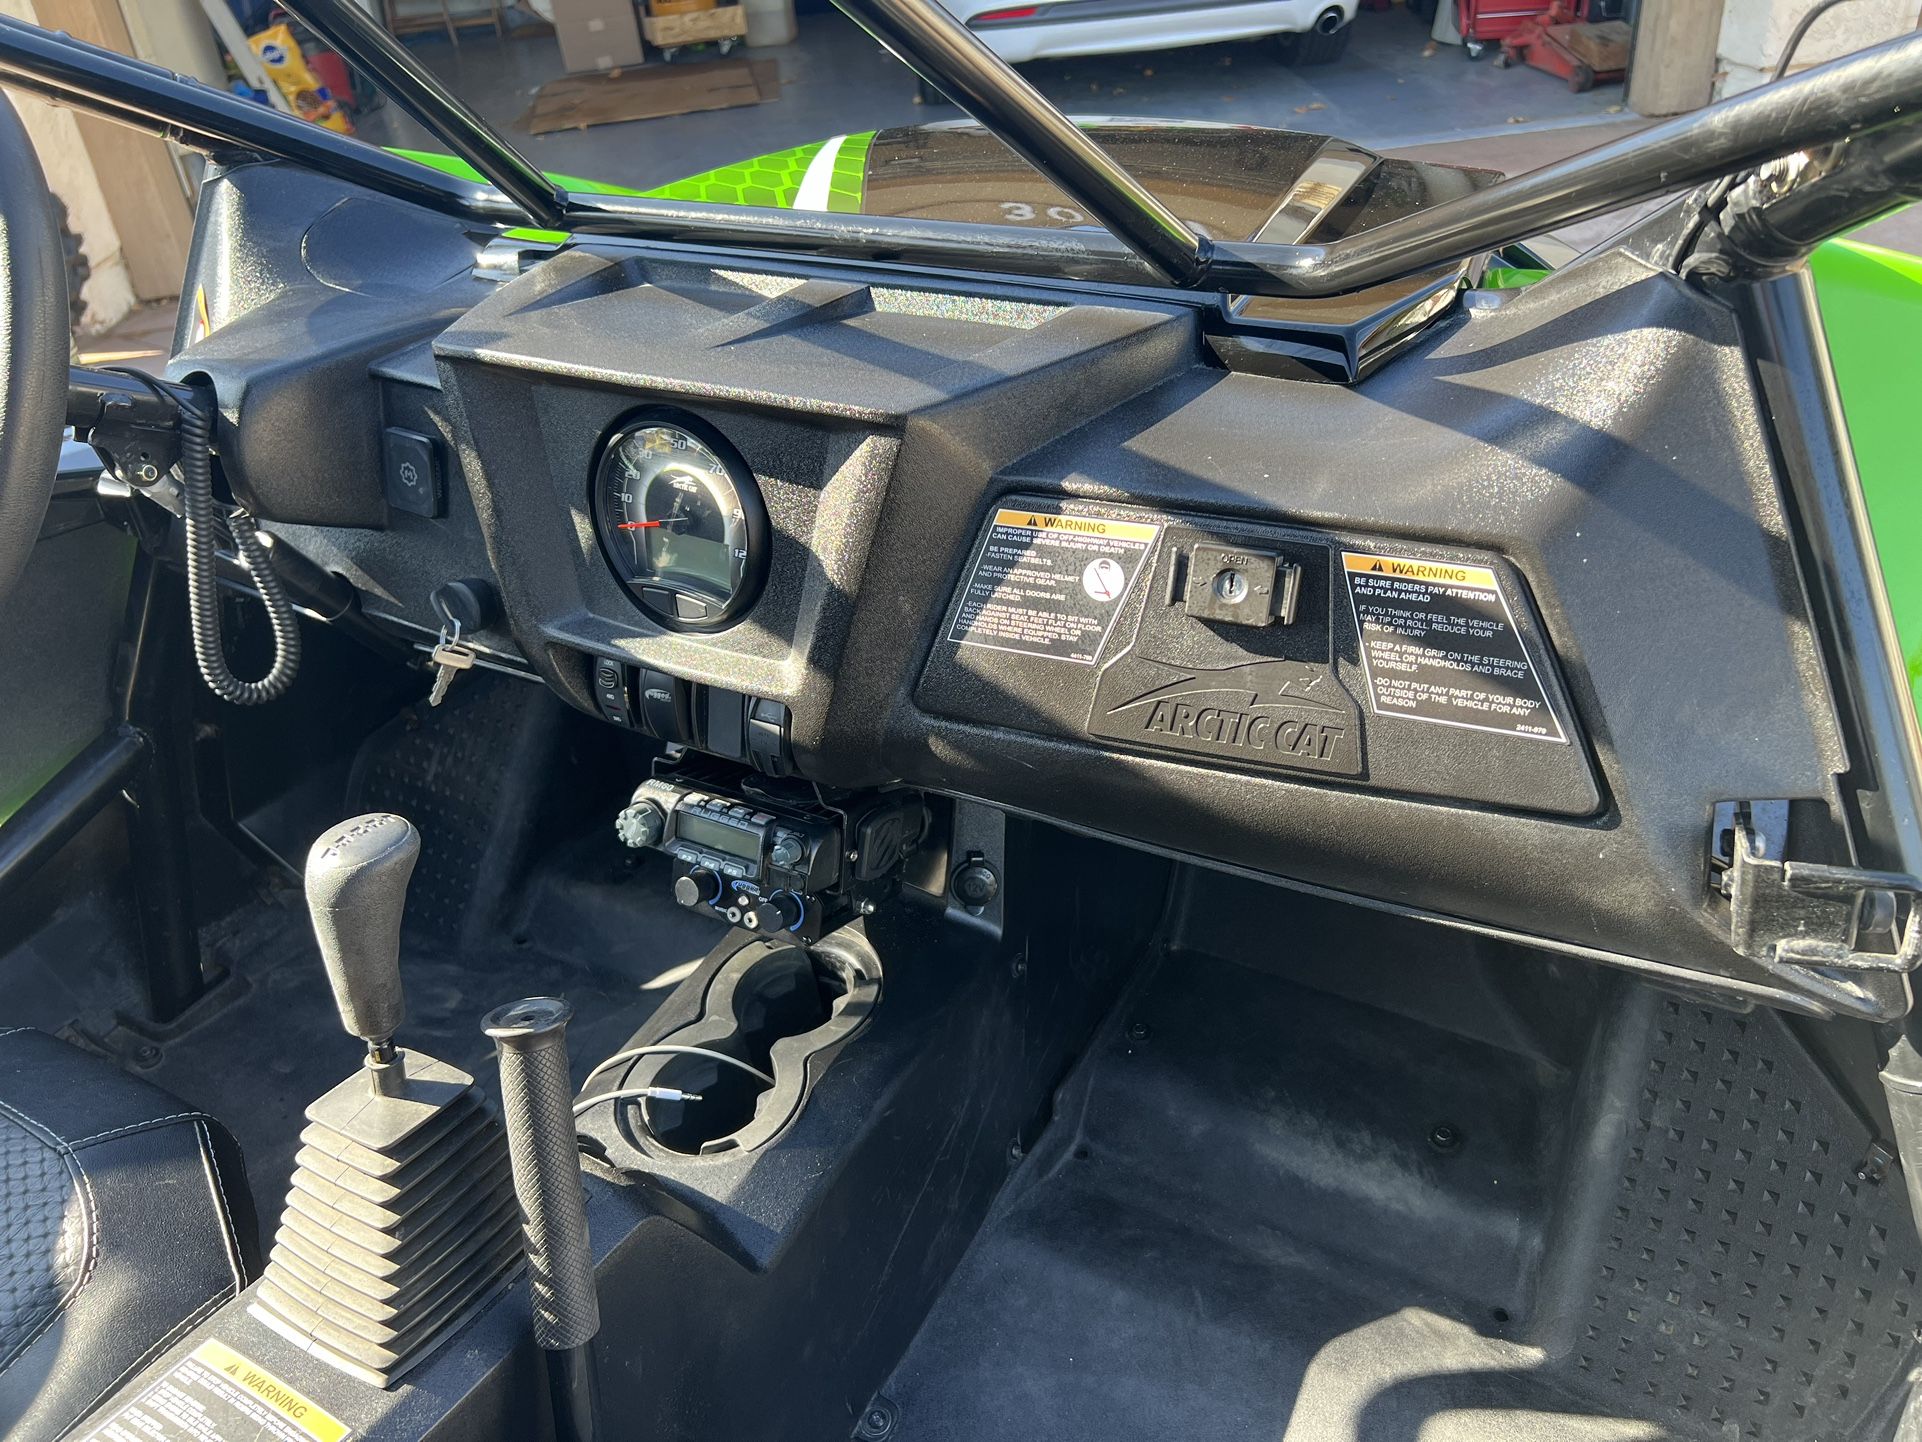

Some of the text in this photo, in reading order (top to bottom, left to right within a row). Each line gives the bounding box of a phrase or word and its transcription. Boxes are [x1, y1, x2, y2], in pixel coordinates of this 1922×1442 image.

[670, 439, 687, 450] 50
[709, 463, 725, 476] 70
[621, 493, 632, 503] 10
[1043, 516, 1107, 534] WARNING
[996, 527, 1031, 536] IMPROPER
[1108, 539, 1145, 549] VEHICLES
[1008, 534, 1031, 543] CAUSE
[1032, 537, 1060, 546] SEVERE
[1061, 540, 1087, 549] INJURY
[1100, 545, 1125, 553] DEATH
[1000, 547, 1036, 556] PREPARED
[1221, 553, 1248, 565] OPEN
[993, 572, 1035, 583] PROTECTIVE
[1013, 568, 1050, 578] APPROVED
[1051, 573, 1079, 582] HELMET
[1392, 563, 1466, 581] WARNING
[970, 588, 990, 596] FULLY
[993, 585, 1012, 593] SURE
[1012, 587, 1025, 595] ALL
[1026, 589, 1050, 598] DOORS
[1051, 593, 1066, 601] ARE
[1355, 577, 1496, 602] BE SURE RIDERS PAY ATTENTION
[1355, 587, 1431, 602] AND PLAN AHEAD
[986, 603, 1007, 612] RIDER
[1008, 606, 1026, 614] MUST
[1066, 621, 1077, 629] ON
[1360, 614, 1377, 622] MAY
[1379, 616, 1391, 624] TIP
[1393, 617, 1405, 626] OR
[1432, 622, 1467, 634] REDUCE
[1469, 627, 1493, 638] YOUR
[1366, 606, 1386, 615] YOU
[1388, 608, 1411, 618] THINK
[1414, 612, 1425, 620] OR
[1428, 613, 1448, 623] FEEL
[1450, 616, 1466, 625] THE
[1469, 618, 1504, 630] VEHICLE
[1363, 622, 1426, 637] RISK OF INJURY
[1371, 641, 1393, 651] KEEP
[1403, 645, 1423, 655] FIRM
[1425, 647, 1446, 658] GRIP
[1448, 651, 1461, 659] ON
[1463, 653, 1480, 662] THE
[1482, 656, 1528, 670] STEERING
[1372, 650, 1524, 678] WHEEL OR HANDHOLDS AND BRACE
[1378, 686, 1531, 716] OUTSIDE OF THE VEHICLE FOR ANY
[1381, 696, 1416, 708] REASON
[1392, 679, 1410, 689] NOT
[1411, 682, 1429, 692] PUT
[1430, 684, 1448, 695] ANY
[1450, 687, 1472, 698] PART
[1474, 690, 1486, 699] OF
[1488, 693, 1514, 704] YOUR
[1516, 697, 1541, 709] BODY
[1144, 700, 1345, 760] ARCTIC CAT
[242, 1371, 308, 1419] WARNING
